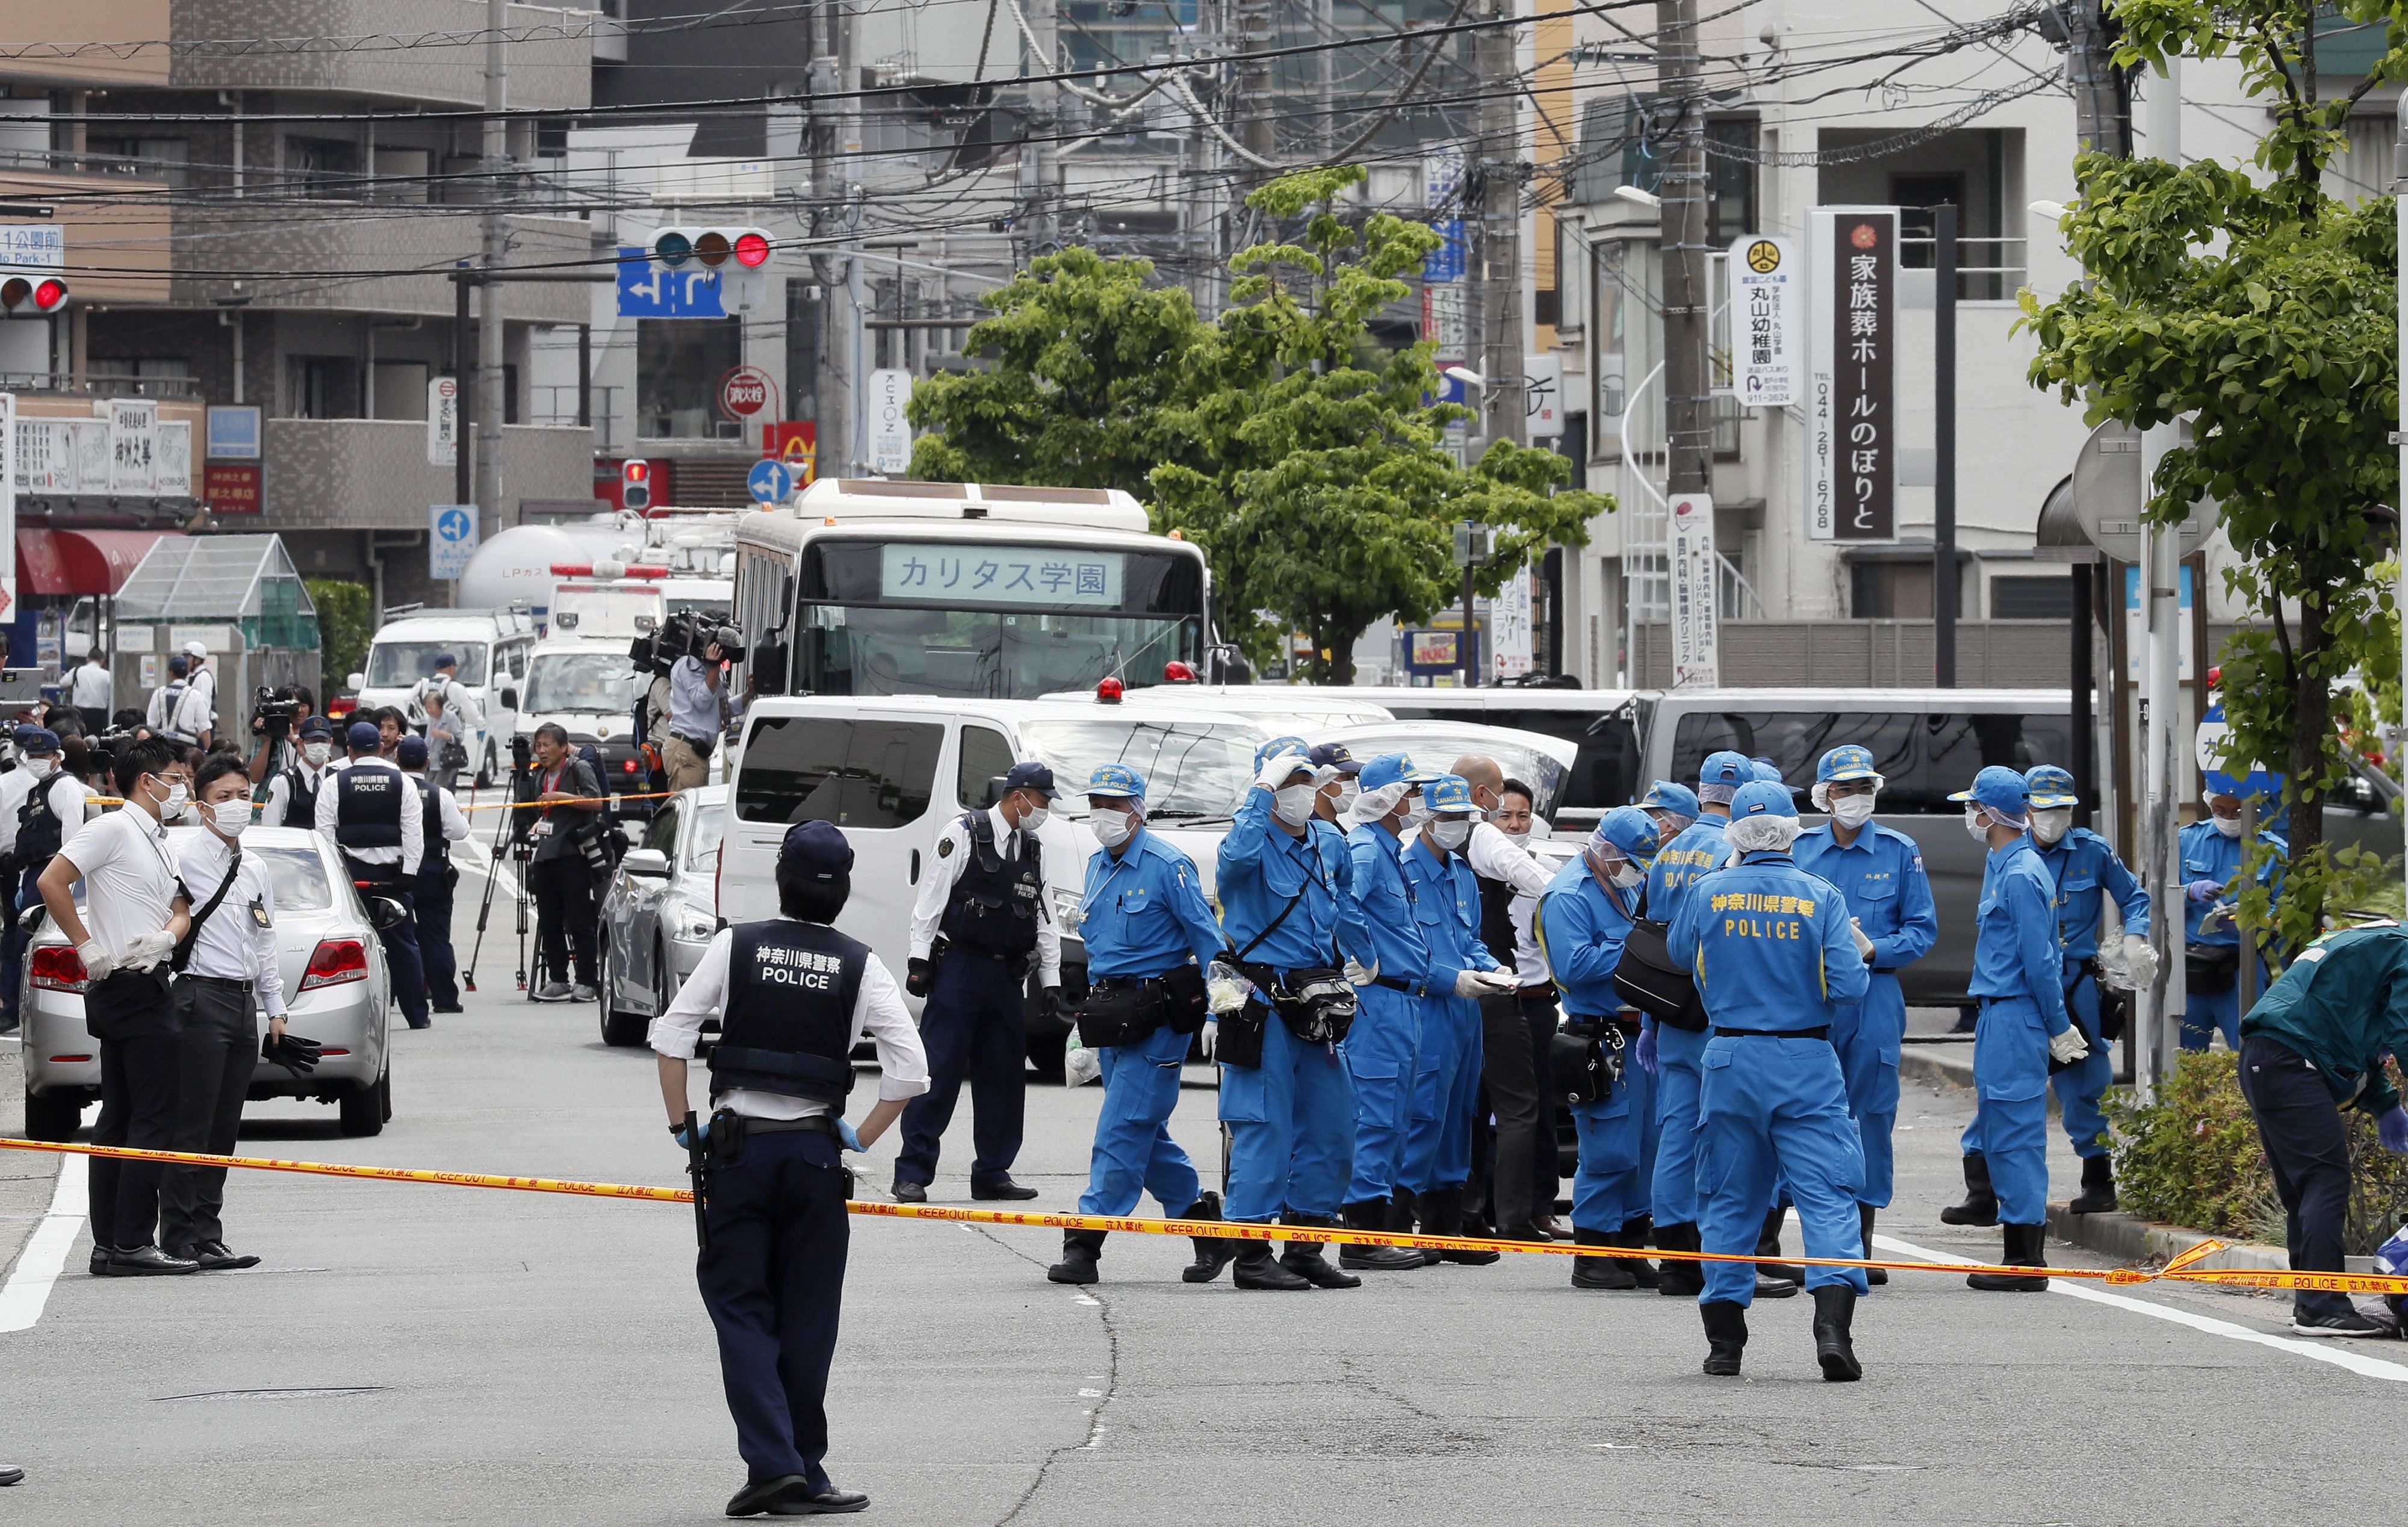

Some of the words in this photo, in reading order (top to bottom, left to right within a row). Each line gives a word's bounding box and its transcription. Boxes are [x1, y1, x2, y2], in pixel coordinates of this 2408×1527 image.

[1751, 286, 1771, 364] 丸山幼稚園
[730, 386, 764, 404] 消火栓
[883, 374, 897, 433] KUMON
[1850, 253, 1878, 528] 家族葬ホールのぼりと
[502, 568, 542, 578] LPガス
[900, 556, 1106, 595] カリタス学園
[1710, 893, 1816, 918] 神奈川県警察
[1725, 919, 1799, 939] POLICE
[756, 945, 841, 974] 神奈川県警察
[762, 967, 830, 990] POLICE
[433, 1171, 464, 1181] KEEP
[557, 1180, 595, 1192] POLICE
[674, 1189, 695, 1200] KEE
[859, 1203, 898, 1215] 立入禁止
[917, 1207, 946, 1218] KEEP
[949, 1210, 973, 1220] OUT
[1044, 1216, 1085, 1228] POLICE
[1105, 1221, 1145, 1231] 立入禁止
[1164, 1224, 1193, 1234] KEEP
[1196, 1227, 1220, 1236] OUT
[1292, 1232, 1332, 1243] POLICE
[2294, 1277, 2338, 1289] POLICE
[2349, 1280, 2392, 1291] 立入禁止
